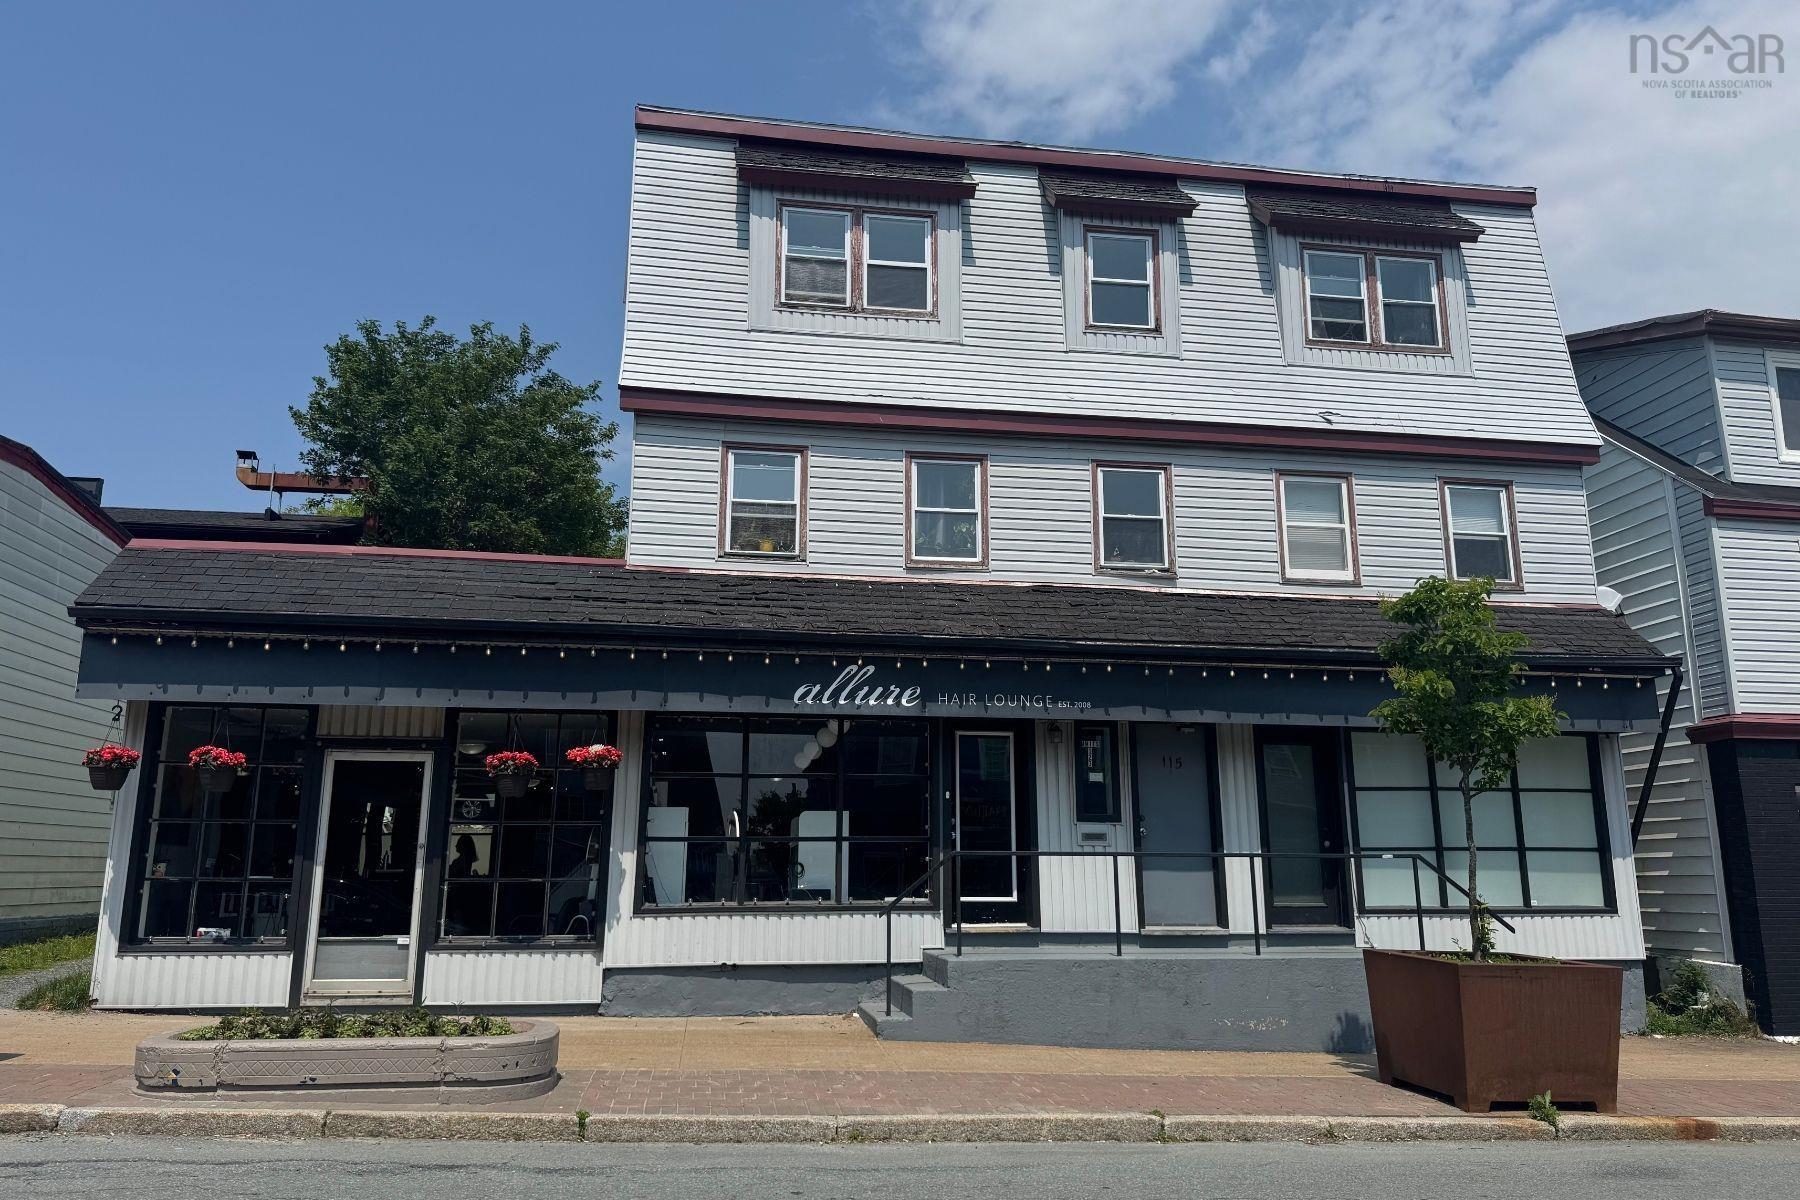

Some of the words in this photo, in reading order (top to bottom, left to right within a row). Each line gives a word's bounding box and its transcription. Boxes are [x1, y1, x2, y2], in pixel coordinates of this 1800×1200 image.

[793, 664, 922, 707] allure
[938, 692, 977, 706] HAIR
[985, 693, 1053, 708] LOUNGE
[1162, 755, 1182, 769] 115
